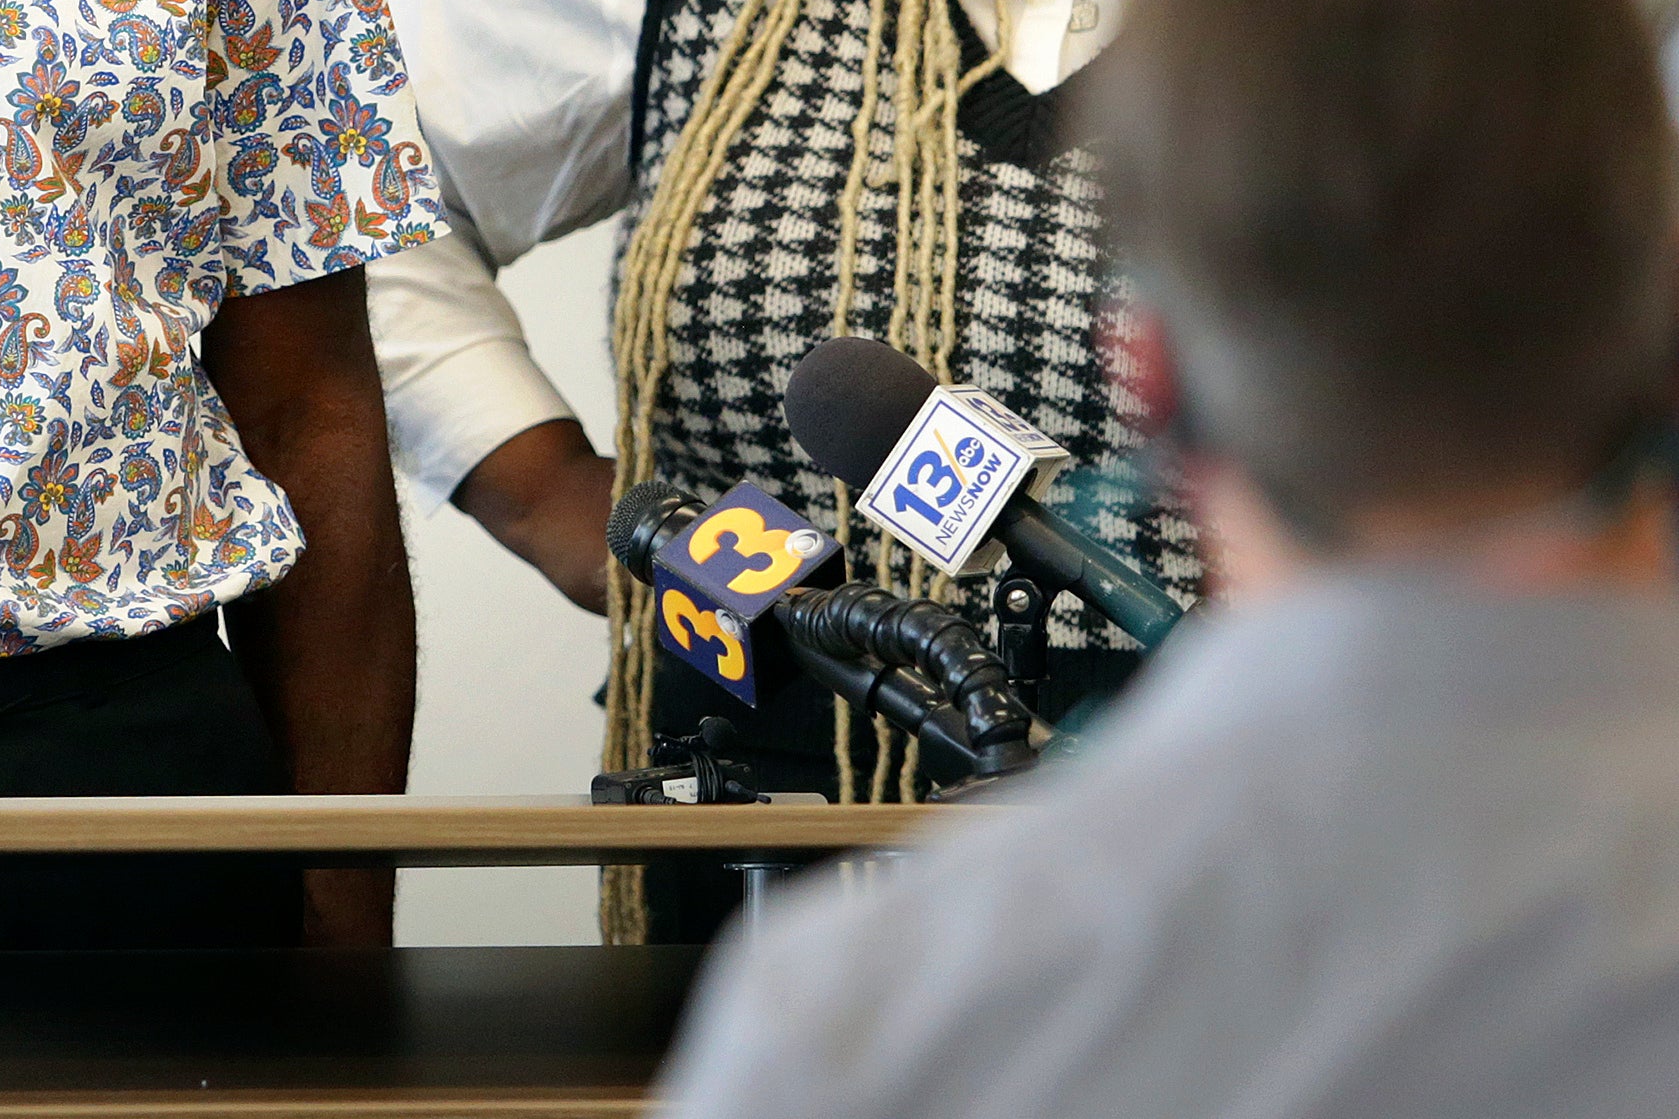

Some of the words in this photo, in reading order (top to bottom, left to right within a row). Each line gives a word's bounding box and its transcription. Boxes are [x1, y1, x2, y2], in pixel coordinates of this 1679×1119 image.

[893, 450, 963, 527] 13
[958, 438, 981, 466] abc
[688, 507, 803, 595] 3
[662, 589, 747, 681] 3
